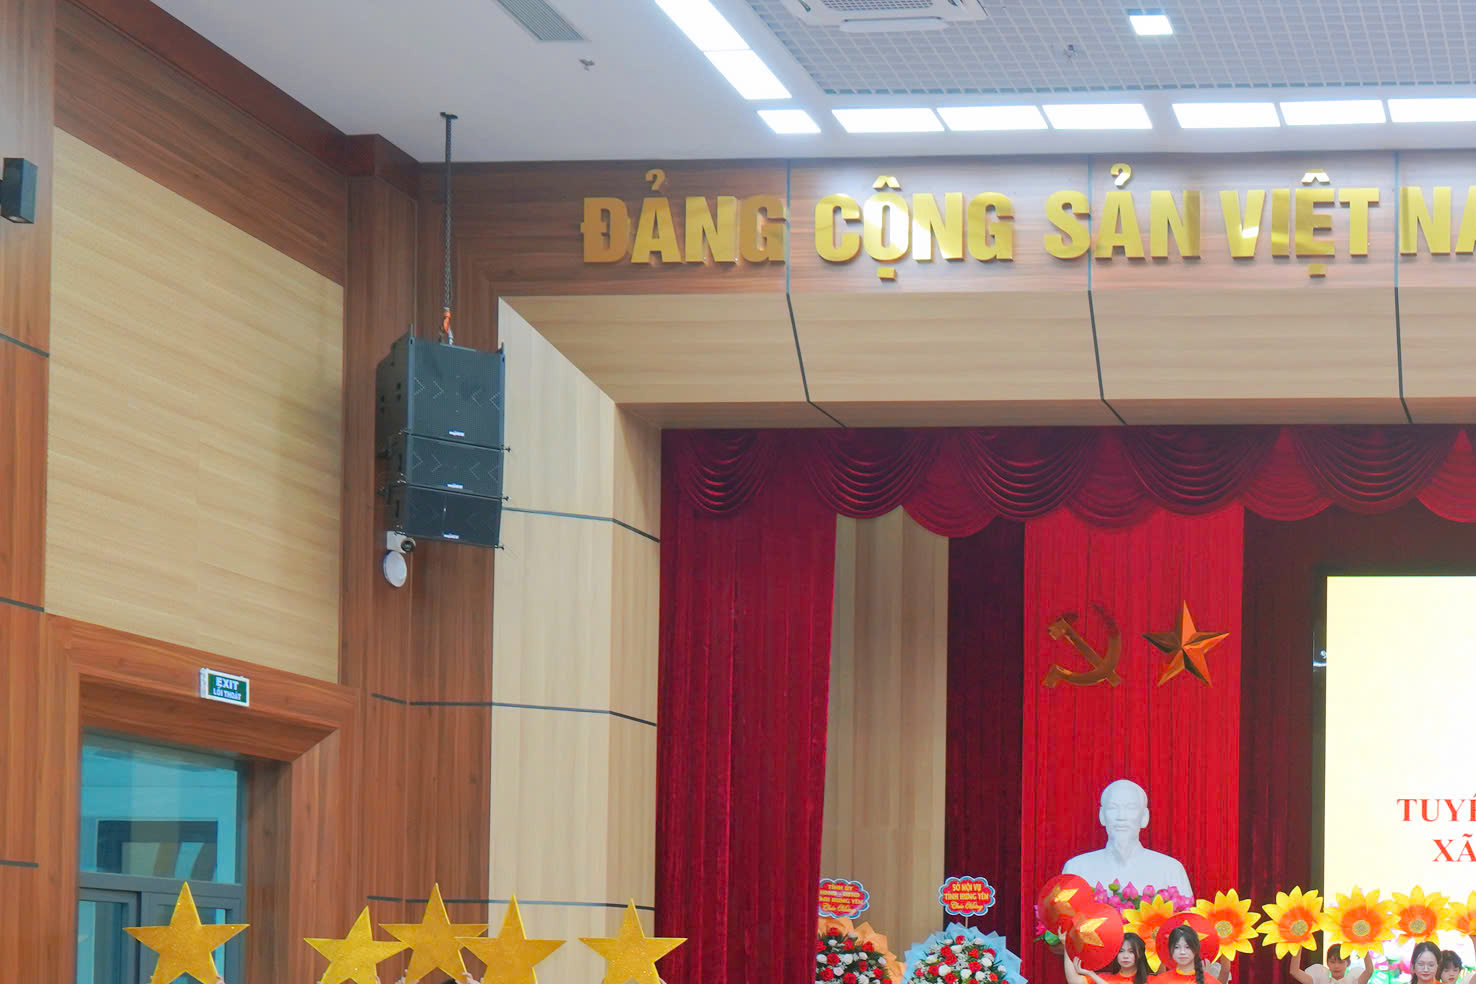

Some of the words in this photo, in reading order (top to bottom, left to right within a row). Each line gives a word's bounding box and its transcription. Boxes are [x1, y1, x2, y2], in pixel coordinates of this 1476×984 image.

[580, 168, 787, 263] ĐẢNG
[815, 175, 1015, 281] CỘNG
[1043, 163, 1201, 260] SẢN
[1219, 168, 1379, 279] VIỆT
[215, 676, 239, 690] EXIT
